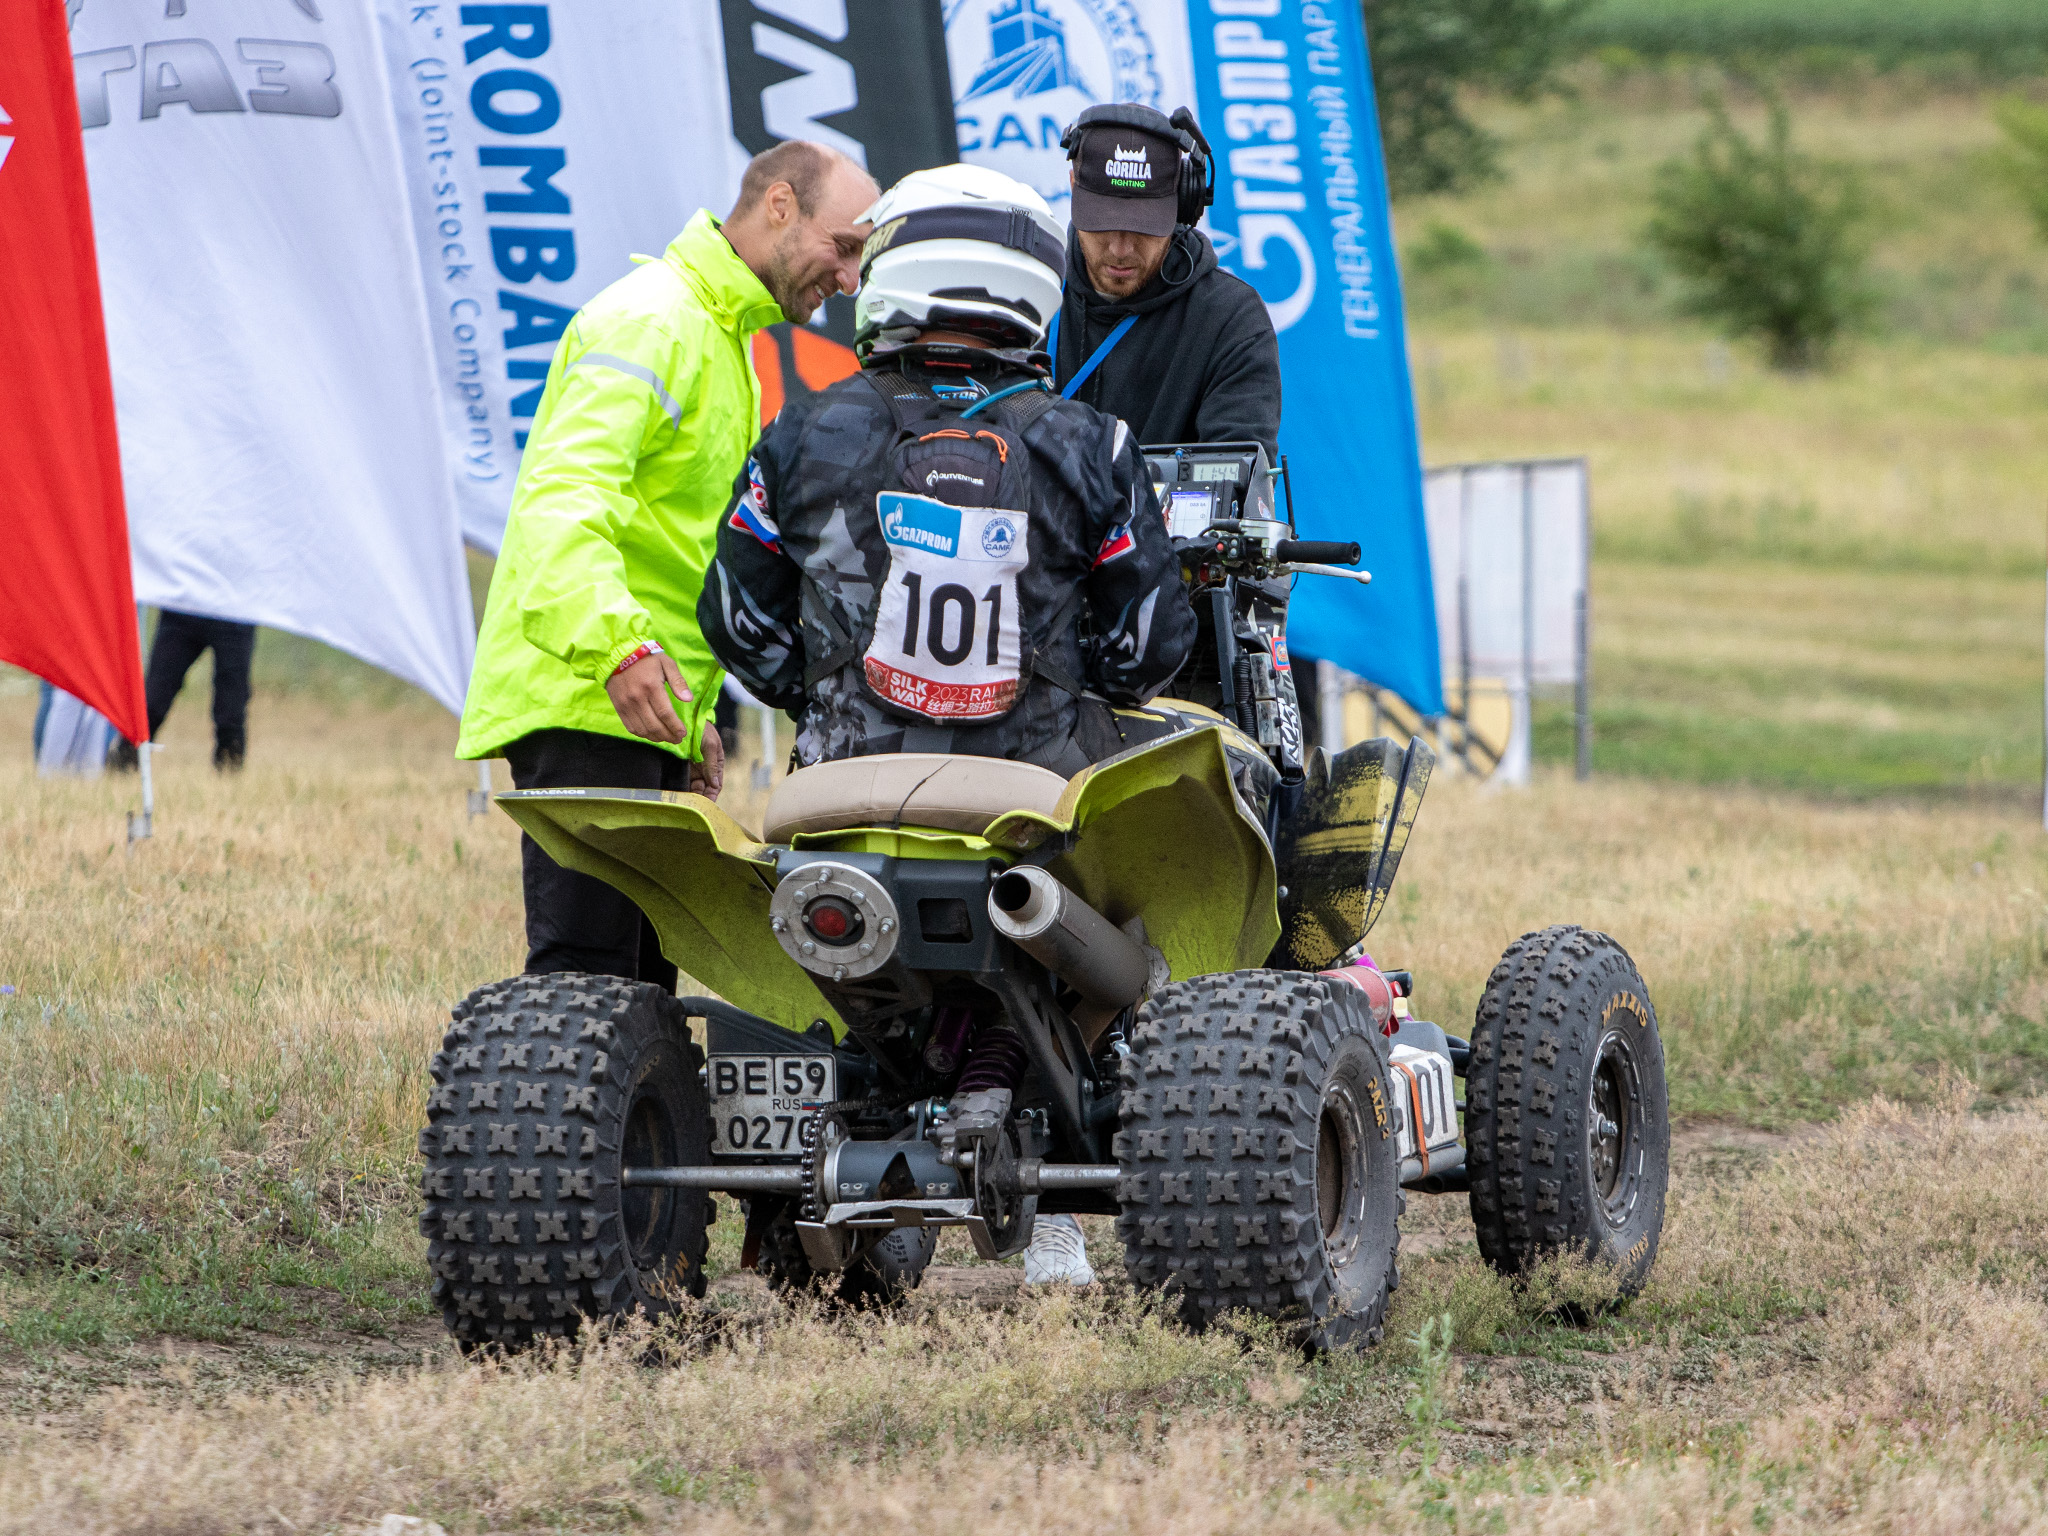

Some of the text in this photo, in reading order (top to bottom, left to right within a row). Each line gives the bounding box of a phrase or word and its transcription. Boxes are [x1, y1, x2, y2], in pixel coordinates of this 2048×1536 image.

[1105, 159, 1152, 179] GORILLA
[1301, 0, 1380, 340] ГЕНЕРАЛЬНЫЙ ПАР
[1111, 178, 1146, 188] FIGHTING
[459, 4, 580, 450] ROMBAN
[409, 57, 475, 282] (Joint-stock
[450, 297, 503, 482] Company)
[938, 391, 978, 401] CTOR
[938, 472, 985, 487] OUTVENTURE
[1200, 466, 1239, 481] 11:44
[901, 528, 953, 553] GAZPROM
[901, 570, 1002, 667] 101
[619, 653, 639, 671] 2023
[890, 671, 928, 696] SILK
[931, 684, 969, 702] 2023
[889, 684, 927, 708] WAY
[1602, 990, 1649, 1028] MAXXIS
[715, 1061, 826, 1096] BE 59
[772, 1098, 801, 1110] RUS
[1367, 1076, 1388, 1128] RAZR
